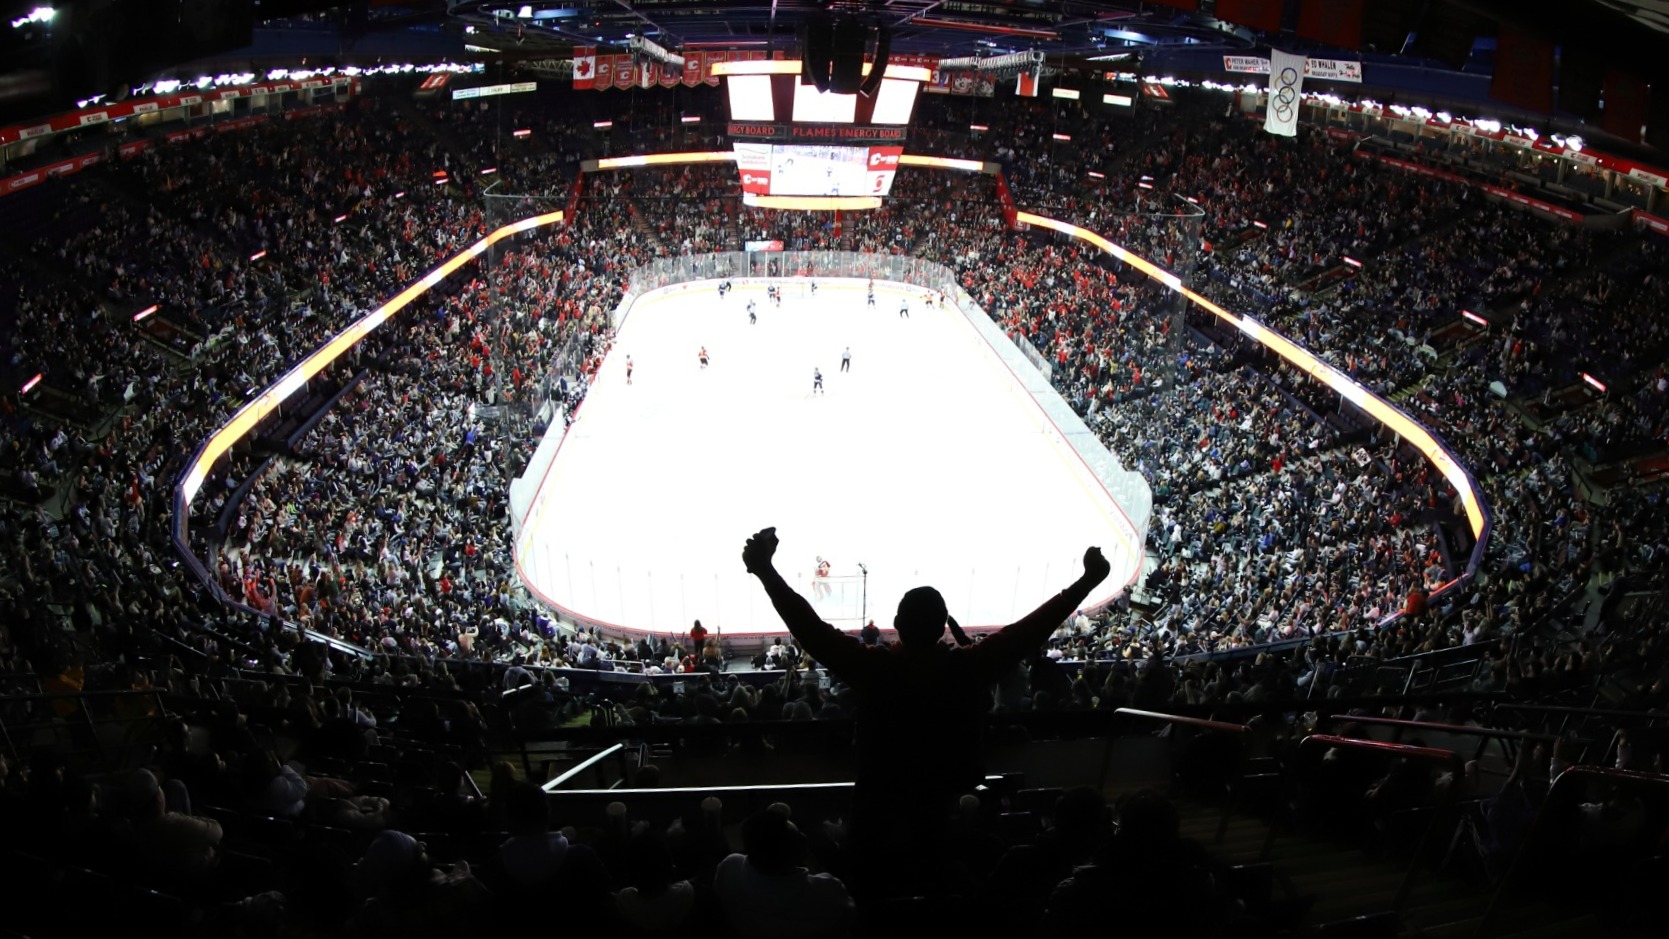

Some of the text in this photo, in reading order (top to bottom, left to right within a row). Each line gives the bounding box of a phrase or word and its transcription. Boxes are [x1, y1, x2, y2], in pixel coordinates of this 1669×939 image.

[1311, 60, 1317, 68] ED
[1318, 60, 1337, 70] WHALEN
[745, 126, 775, 136] BOARD
[793, 127, 902, 138] FLAMES ENERGY BOARD
